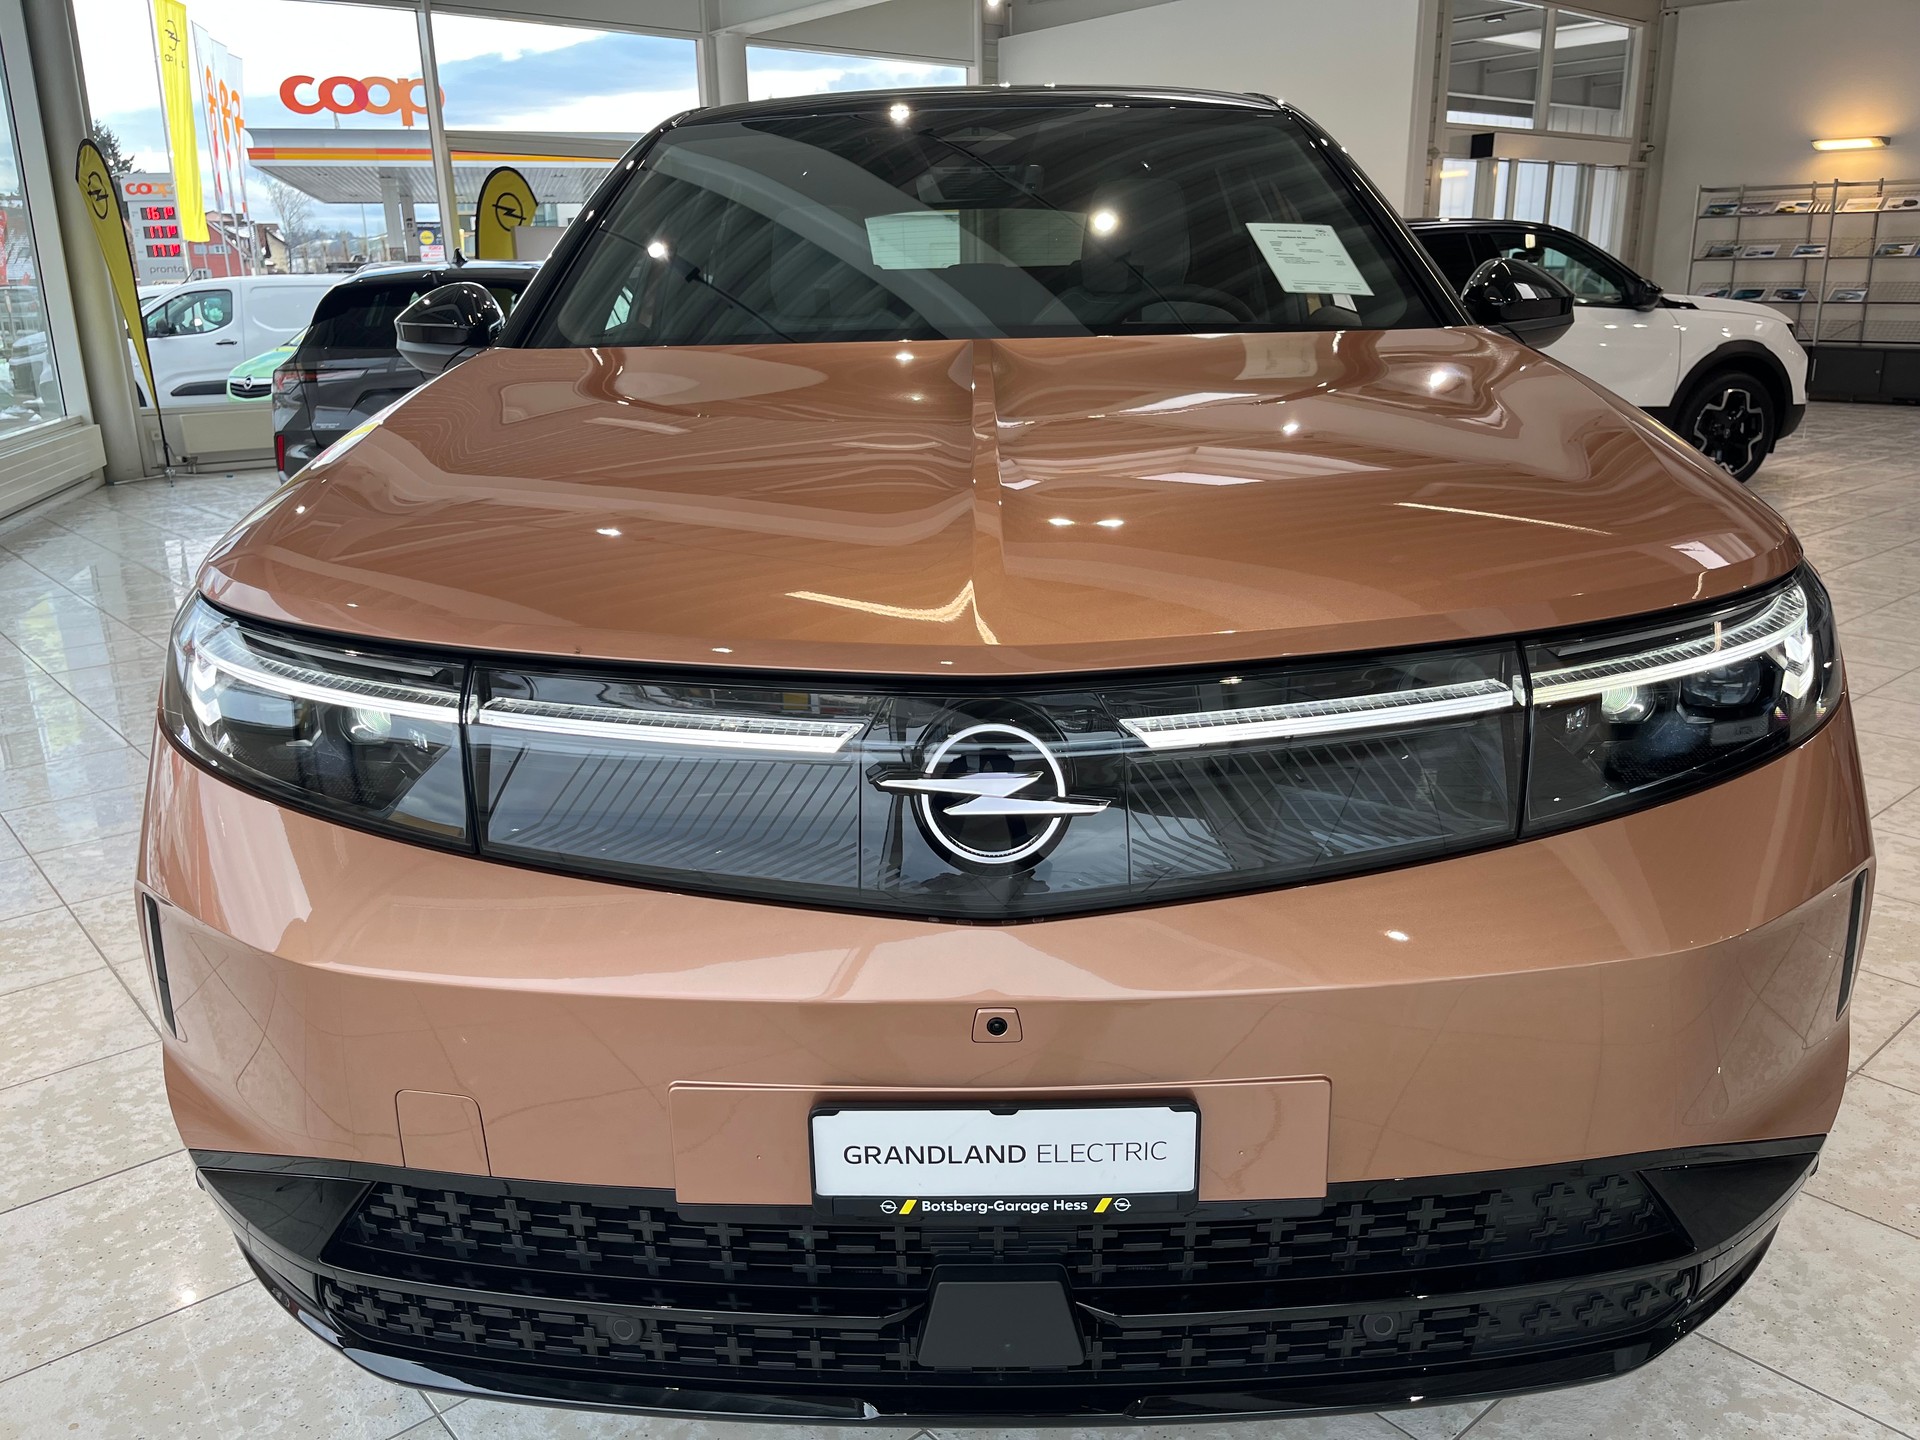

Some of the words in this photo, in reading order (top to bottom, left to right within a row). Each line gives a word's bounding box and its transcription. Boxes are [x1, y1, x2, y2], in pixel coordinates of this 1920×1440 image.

[279, 75, 445, 127] coop
[149, 265, 185, 274] pronto
[843, 1144, 1026, 1165] GRANDLAND
[1037, 1140, 1167, 1164] ELECTRIC
[921, 1200, 1050, 1214] Botsberg-Garage
[1053, 1199, 1088, 1211] Hess
